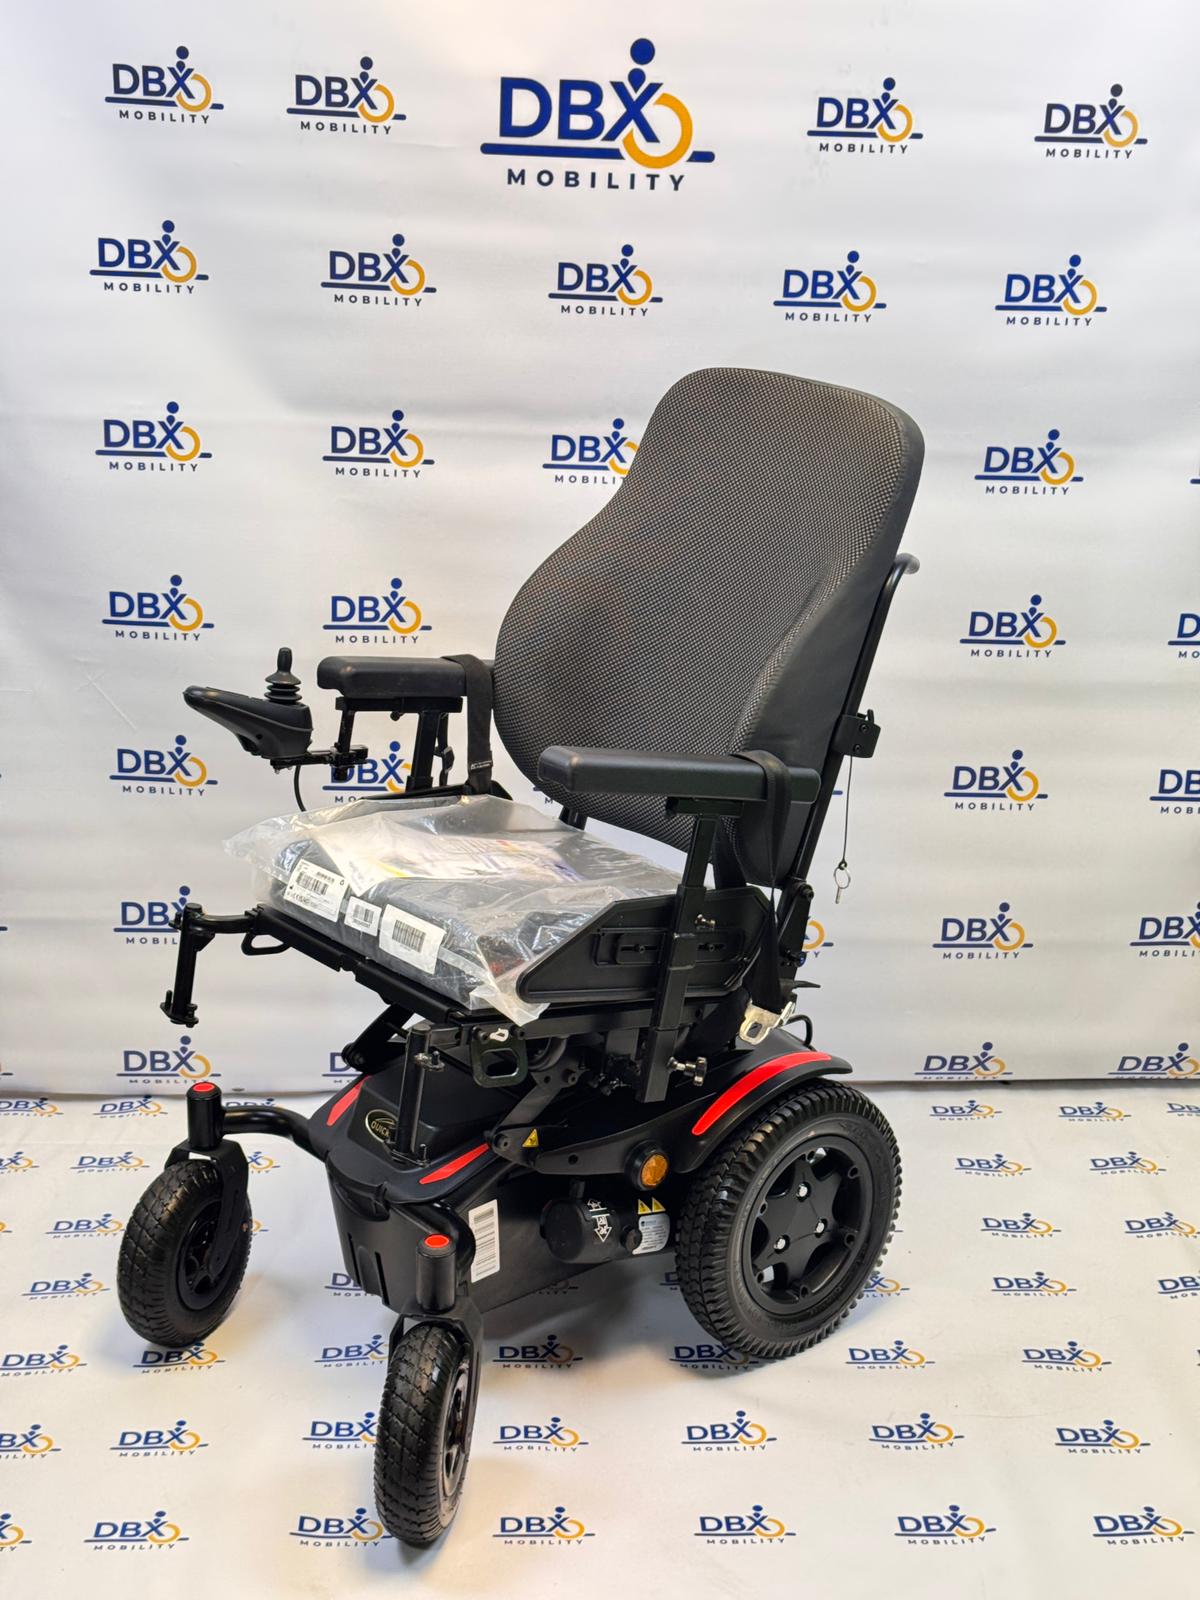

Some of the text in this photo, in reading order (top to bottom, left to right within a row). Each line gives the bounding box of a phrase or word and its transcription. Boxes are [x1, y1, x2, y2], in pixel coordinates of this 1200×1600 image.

[113, 64, 195, 99] DBX
[295, 74, 378, 110] DBX
[119, 110, 209, 124] MOBILITY
[499, 77, 663, 143] DBX
[816, 97, 898, 130] DBX
[1044, 103, 1125, 135] DBX
[300, 121, 392, 135] MOBILITY
[819, 143, 908, 154] MOBILITY
[1046, 149, 1133, 159] MOBILITY
[507, 168, 685, 191] MOBILITY
[98, 237, 180, 271] DBX
[329, 251, 409, 283] DBX
[558, 262, 636, 293] DBX
[783, 269, 862, 300] DBX
[104, 282, 195, 294] MOBILITY
[1004, 274, 1084, 303] DBX
[334, 294, 422, 306] MOBILITY
[561, 305, 648, 316] MOBILITY
[785, 312, 872, 323] MOBILITY
[1006, 316, 1092, 327] MOBILITY
[103, 419, 184, 450] DBX
[331, 426, 408, 456] DBX
[552, 435, 628, 463] DBX
[109, 461, 198, 472] MOBILITY
[984, 447, 1061, 473] DBX
[335, 467, 421, 478] MOBILITY
[555, 475, 625, 484] MOBILI
[985, 486, 1070, 495] MOBILITY
[109, 591, 188, 620] DBX
[331, 596, 406, 623] DBX
[969, 611, 1044, 638] DBX
[115, 630, 201, 641] MOBILITY
[335, 635, 419, 644] MOBILITY
[971, 649, 1052, 658] MOBILITY
[117, 748, 192, 777] DBX
[952, 765, 1025, 791] DBX
[1158, 769, 1200, 794] DB
[122, 786, 205, 797] MOBILITY
[955, 802, 1035, 811] MOBILITY
[941, 917, 1012, 941] DBX
[123, 1051, 196, 1072] DBX
[923, 1055, 994, 1071] DBX
[1118, 1056, 1190, 1071] DBX
[101, 1100, 151, 1112] DBX
[932, 1104, 980, 1114] DBX
[1059, 1105, 1108, 1115] DBX
[78, 1156, 134, 1166] DBX
[957, 1158, 1009, 1169] DBX
[1090, 1157, 1146, 1168] DBX
[54, 1220, 112, 1231] DBX
[983, 1218, 1040, 1230] DBX
[1125, 1217, 1184, 1231] DBX
[30, 1280, 92, 1293] DBX
[993, 1277, 1054, 1289] DBX
[1158, 1276, 1200, 1290] DB
[141, 1350, 206, 1364] DBX
[322, 1342, 384, 1359] DBX
[499, 1343, 561, 1358] DBX
[848, 1347, 909, 1362] DBX
[1023, 1349, 1084, 1361] DBX
[2, 1352, 66, 1367] DBX
[311, 1421, 378, 1437] DBX
[500, 1425, 565, 1440] DBX
[686, 1421, 752, 1440] DBX
[872, 1422, 940, 1439] DBX
[1056, 1427, 1121, 1442] DBX
[0, 1433, 42, 1447] BX
[119, 1429, 187, 1446] DBX
[93, 1521, 168, 1538] DBX
[298, 1515, 369, 1534] DBX
[500, 1516, 569, 1533] DBX
[700, 1515, 769, 1532] DBX
[897, 1514, 970, 1532] DBX
[1094, 1515, 1165, 1532] DBX
